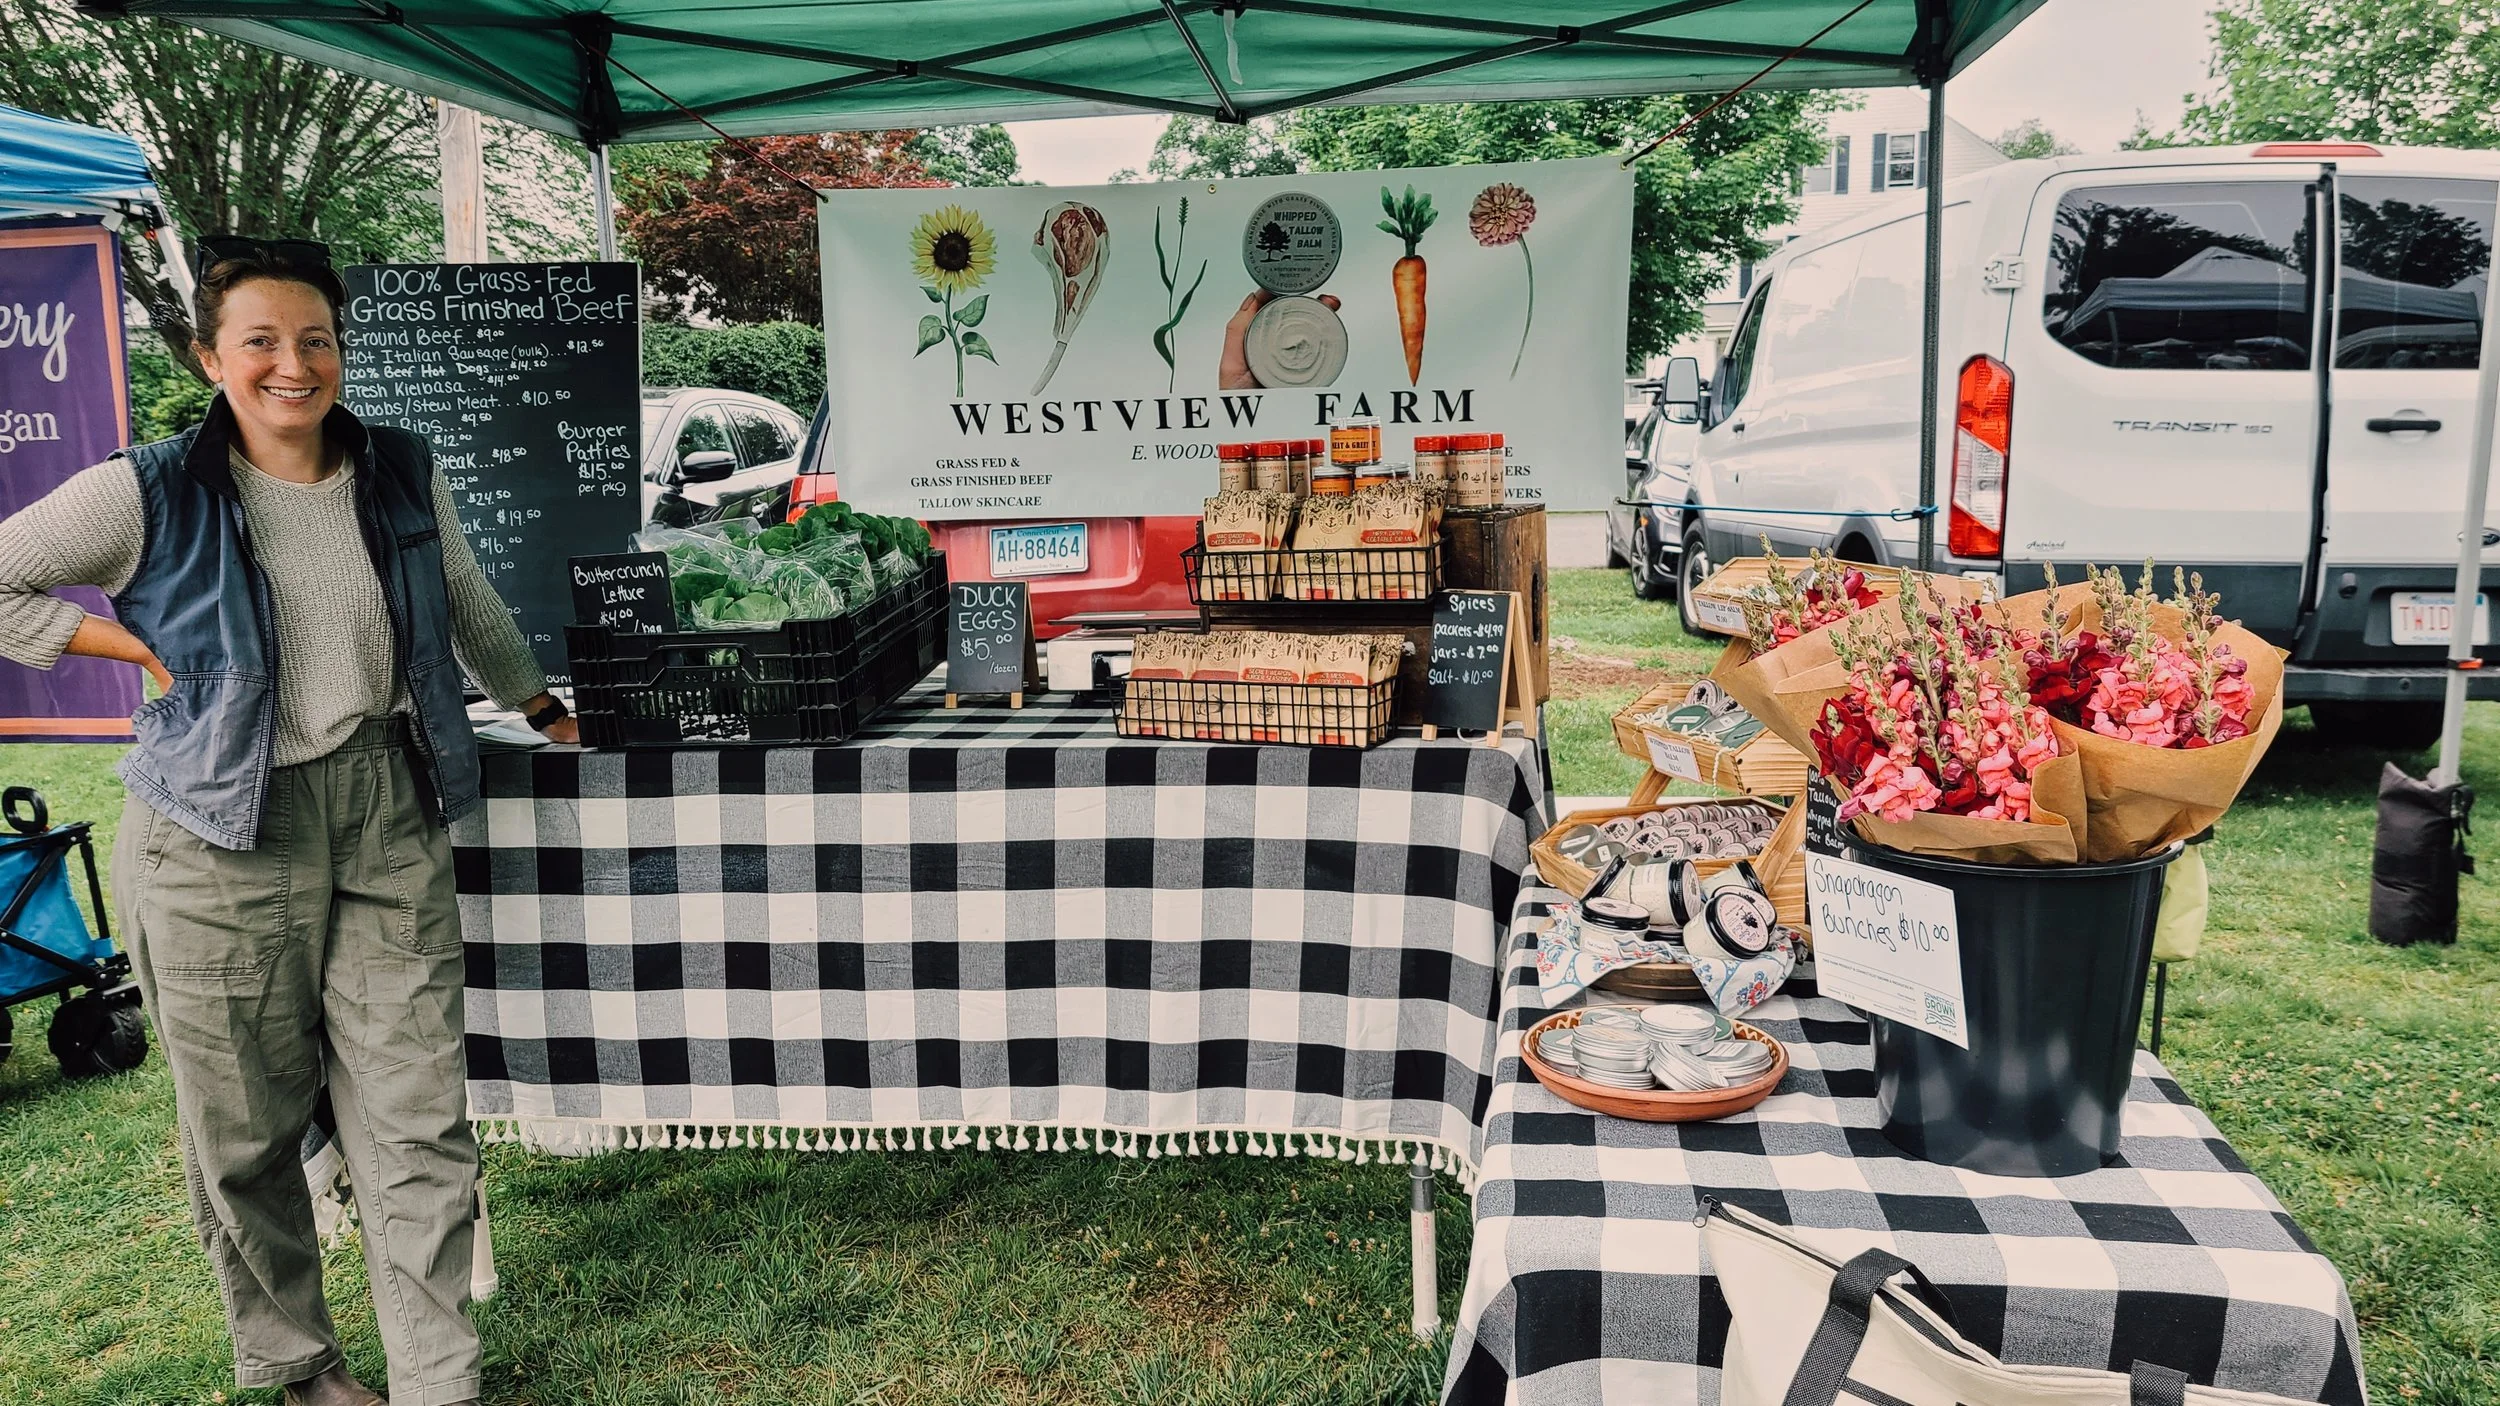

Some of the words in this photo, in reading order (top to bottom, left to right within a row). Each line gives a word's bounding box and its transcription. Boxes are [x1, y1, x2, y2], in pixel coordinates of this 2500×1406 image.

[1274, 211, 1317, 221] WHIPPED
[1288, 226, 1325, 235] TALLOW
[1296, 239, 1322, 248] BALM
[374, 266, 442, 296] 100%
[351, 295, 436, 323] Grass
[444, 295, 544, 322] Finished
[551, 293, 633, 322] Beef
[344, 329, 410, 347] Ground
[476, 328, 504, 343] $9.00
[380, 348, 442, 364] Italian
[566, 339, 604, 354] $12.50
[345, 367, 380, 381] 100%
[383, 365, 416, 379] Beef
[421, 363, 447, 378] Hot
[510, 359, 548, 372] $14.50
[345, 384, 388, 399] Fresh
[487, 373, 520, 388] $14.00
[522, 390, 571, 406] $10.50
[461, 413, 492, 428] $9.50
[949, 395, 1263, 436] WESTVIEW
[1315, 389, 1474, 426] FARM
[557, 420, 627, 447] Burger
[2113, 420, 2239, 433] TRANSIT
[2244, 424, 2273, 434] 150
[432, 433, 472, 448] $12.00
[491, 446, 527, 464] $18.50
[566, 439, 631, 463] Patties
[1131, 445, 1147, 460] E.
[578, 461, 625, 481] $15.00
[935, 458, 978, 469] GRASS
[981, 457, 1007, 468] FED
[1010, 457, 1020, 467] &
[578, 483, 595, 496] per
[602, 481, 627, 497] pkg
[910, 476, 952, 487] GRASS
[956, 475, 1016, 486] FINISHED
[1020, 474, 1053, 485] BEEF
[467, 490, 511, 506] $24.50
[918, 497, 973, 509] TALLOW
[976, 496, 1042, 508] SKINCARE
[496, 508, 541, 527] $19.50
[1016, 528, 1059, 537] Connecticut
[479, 536, 523, 555] $16.00
[478, 561, 515, 580] 14.00
[573, 562, 664, 587] Buttercrunch
[602, 584, 645, 605] Lettuce
[958, 586, 1016, 608] DUCK
[1449, 594, 1496, 615] Spices
[599, 607, 634, 628] $4.00
[958, 610, 1017, 632] EGGS
[2399, 606, 2456, 630] TWID
[961, 633, 1013, 661] $5.00
[989, 661, 1018, 674] /dozen
[1462, 669, 1494, 685] $10.00
[1808, 787, 1837, 808] Tallow
[1807, 827, 1821, 843] Face
[1825, 832, 1845, 849] Balm
[1813, 858, 1903, 915] Snapdragon
[1822, 903, 1897, 953] Bunches
[1899, 911, 1949, 953] $10.00
[1924, 999, 1956, 1019] GROWN
